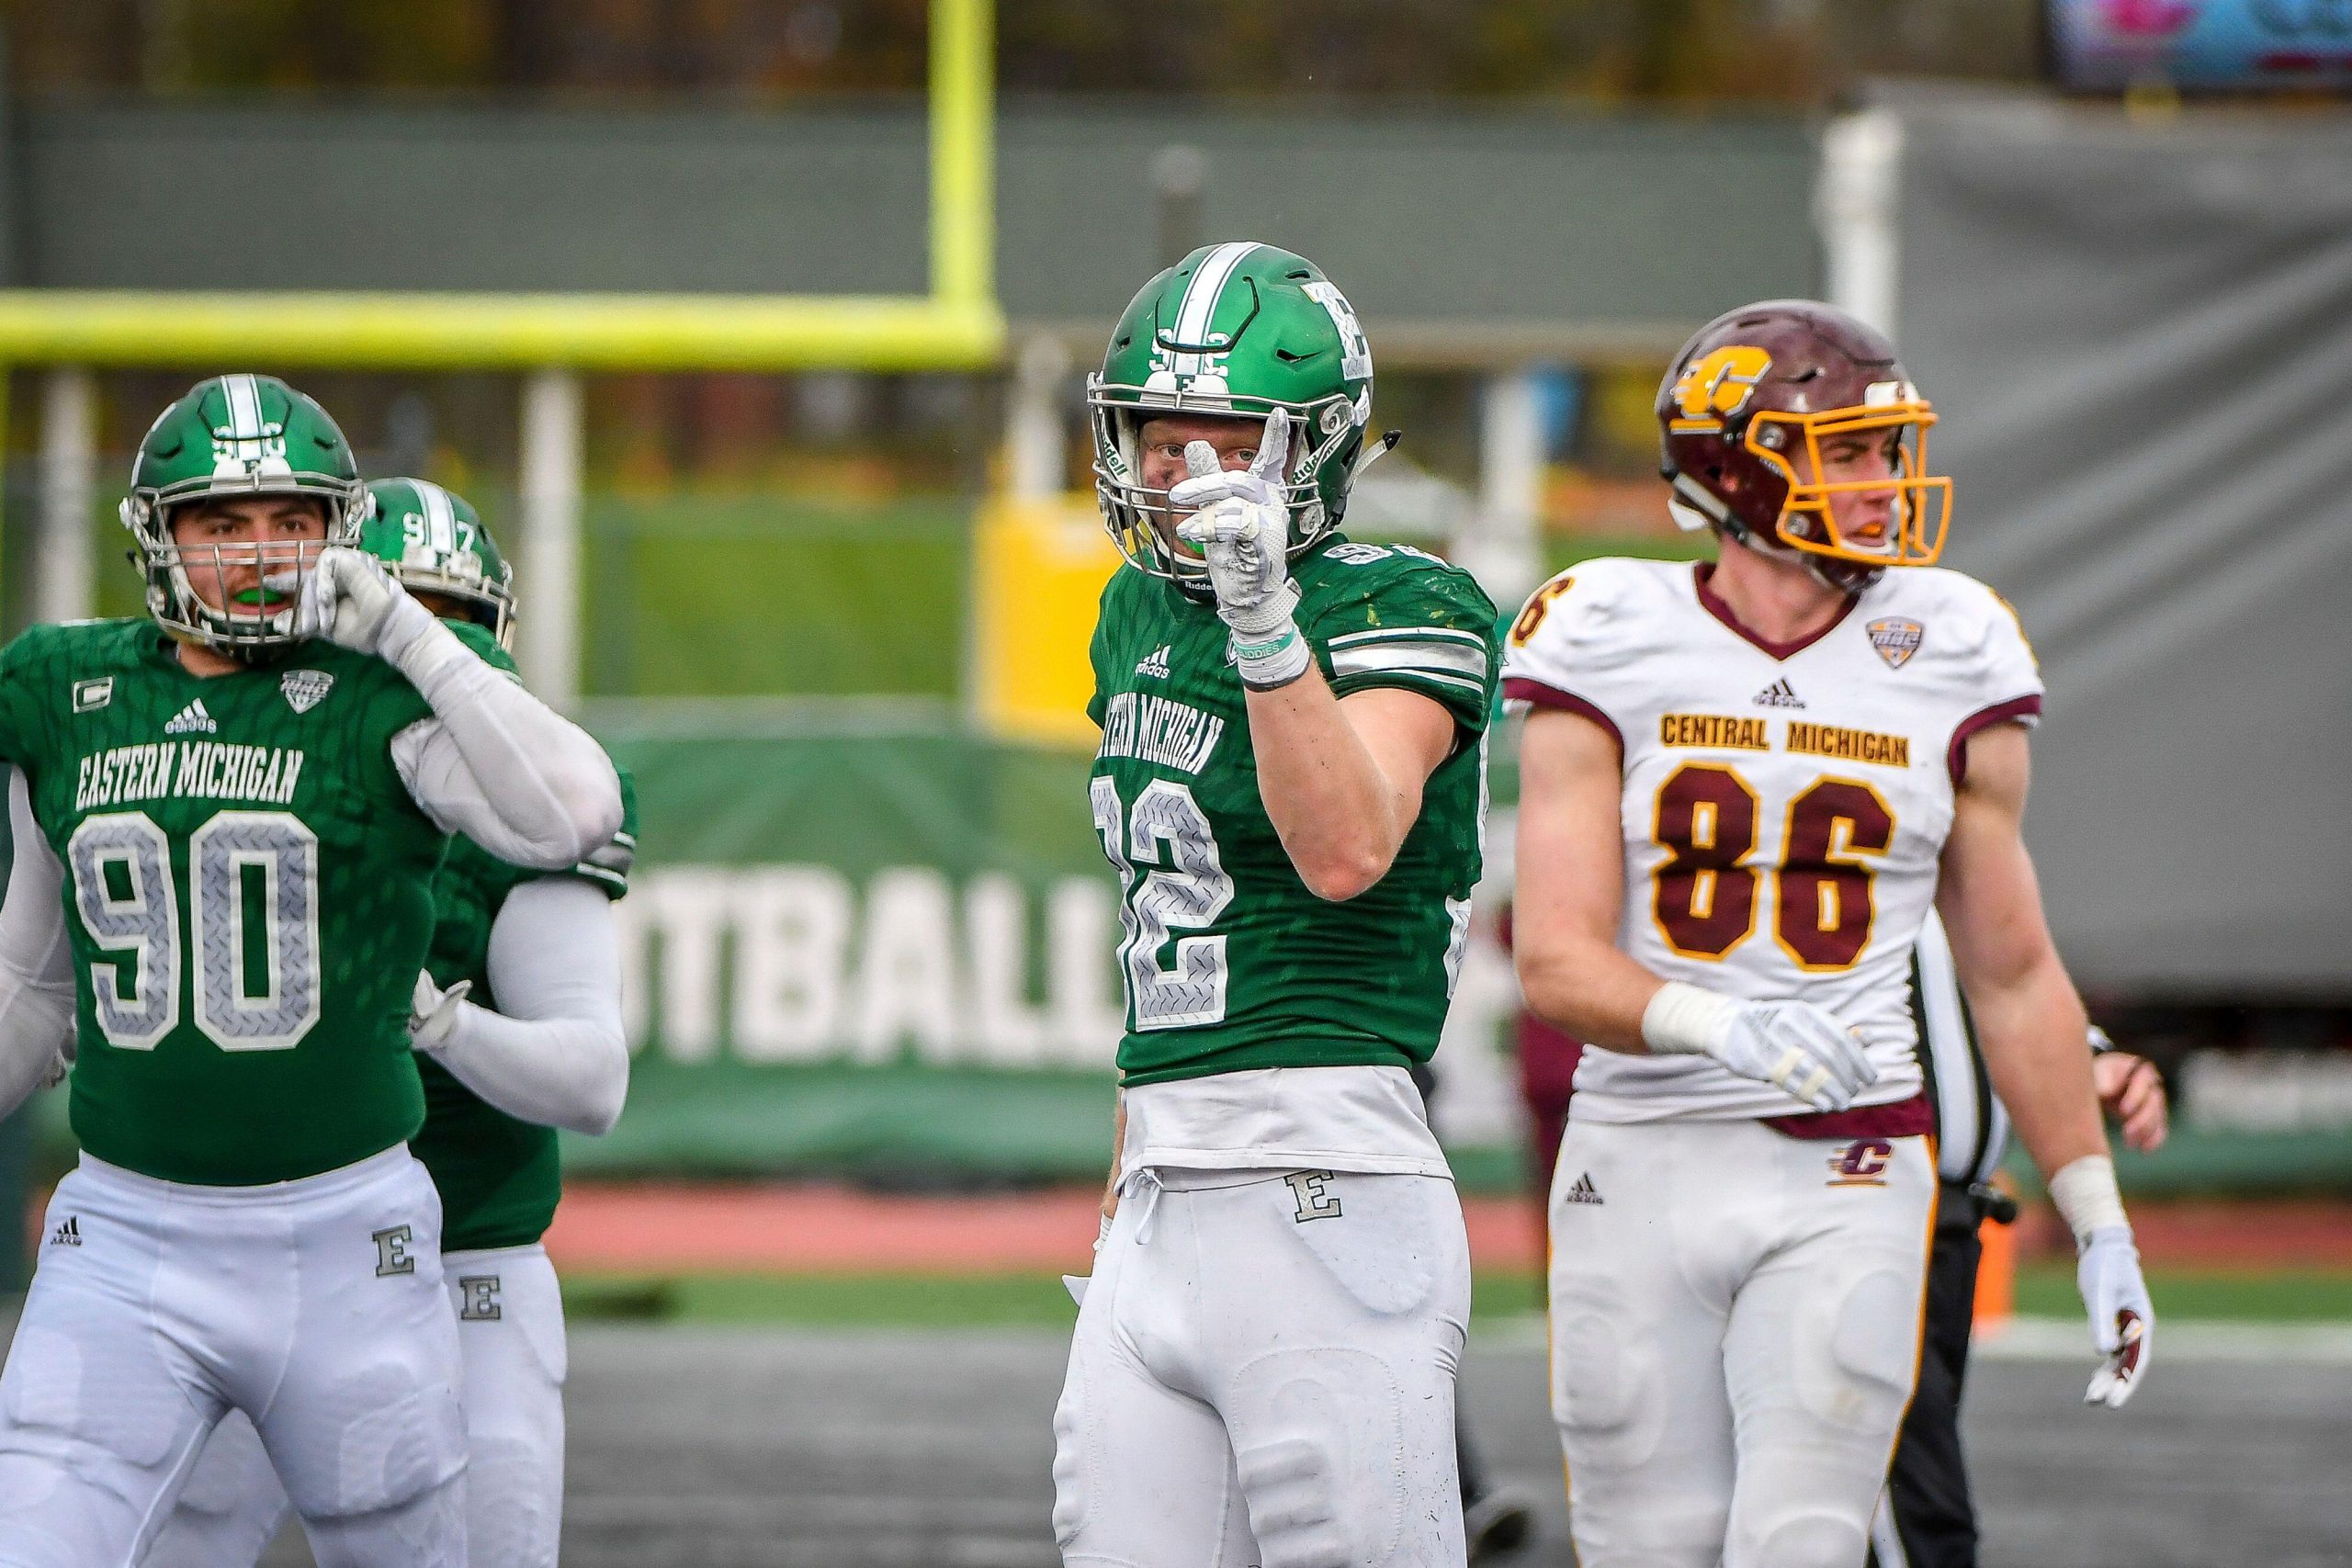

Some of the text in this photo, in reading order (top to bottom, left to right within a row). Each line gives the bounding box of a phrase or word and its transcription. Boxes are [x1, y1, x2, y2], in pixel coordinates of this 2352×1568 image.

[1135, 693, 1225, 776] MICHIGAN
[1660, 714, 1770, 751] CENTRAL
[1785, 719, 1910, 769] MICHIGAN
[75, 741, 175, 812] EASTERN
[173, 740, 304, 805] MICHIGAN
[1649, 761, 1898, 974] 86
[67, 809, 321, 1052] 90
[1283, 1168, 1342, 1224] E
[372, 1224, 414, 1277] E
[459, 1274, 501, 1320] E
